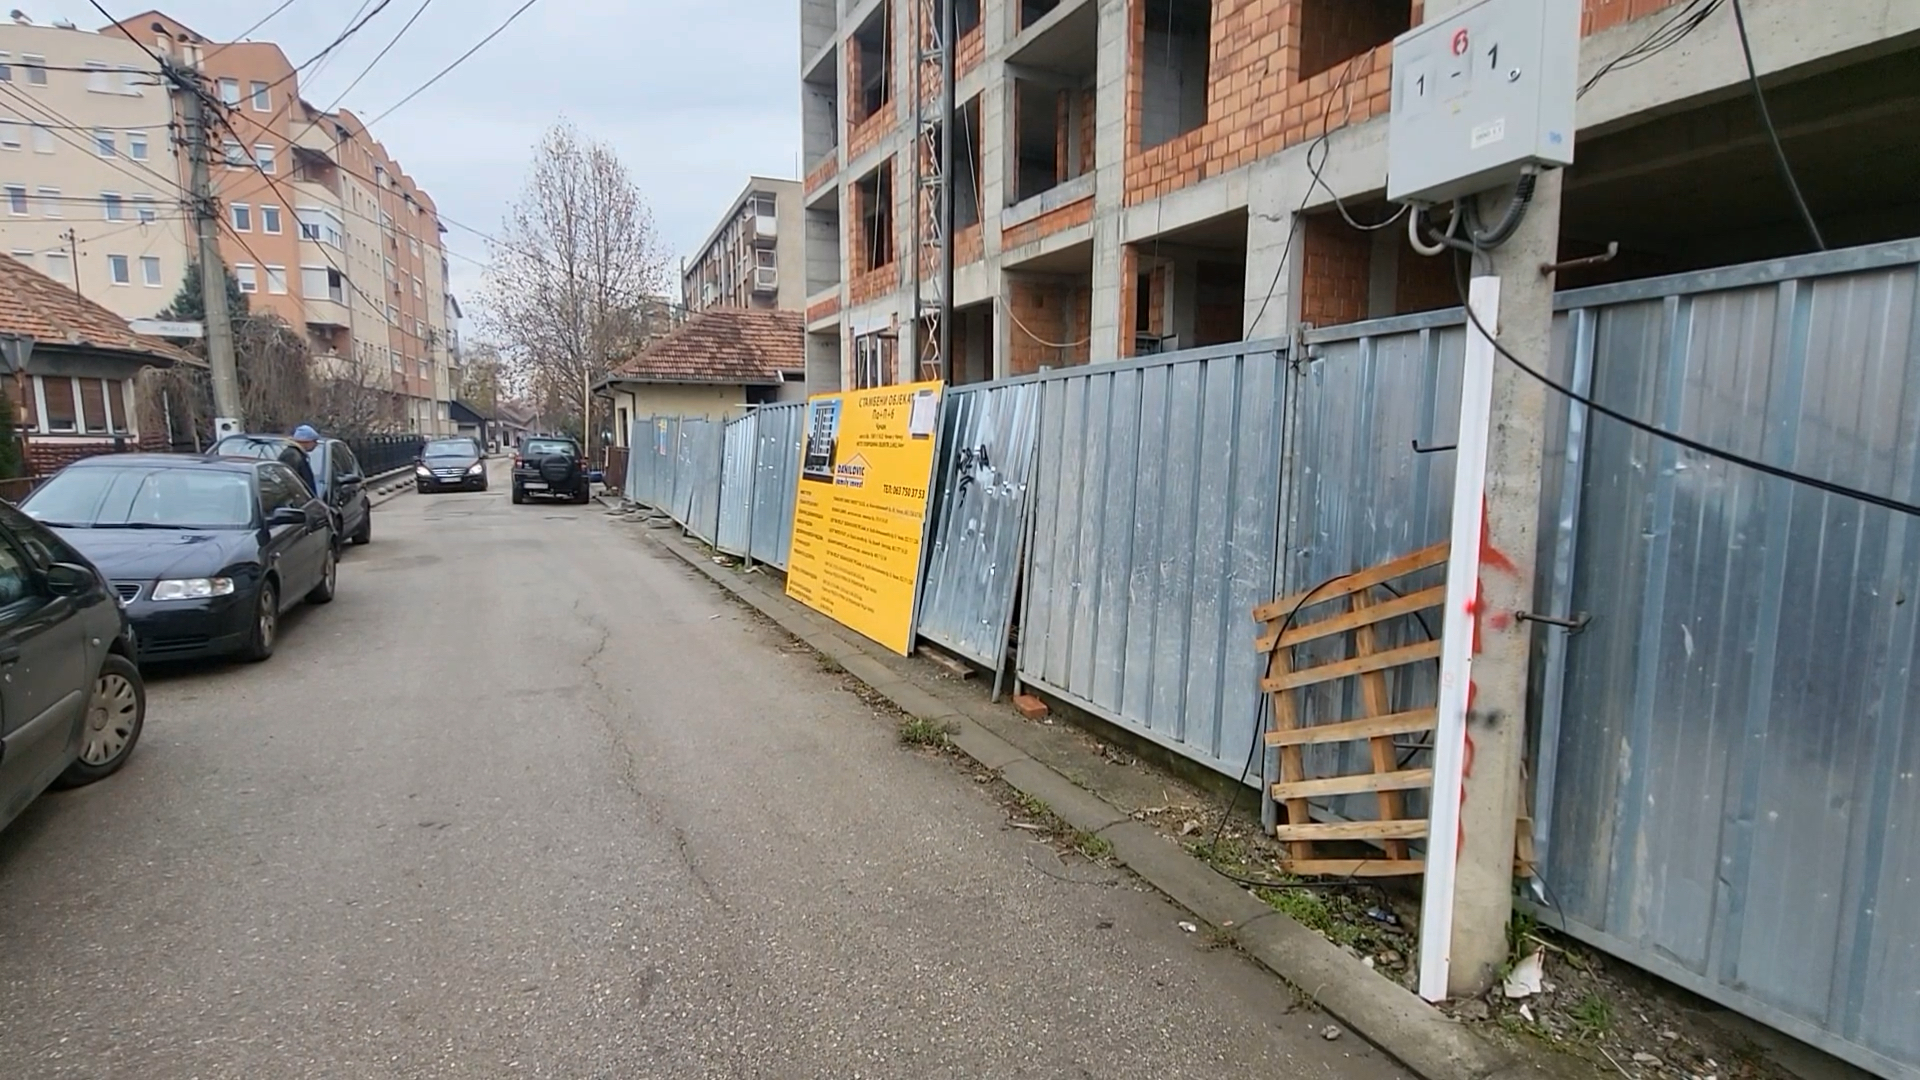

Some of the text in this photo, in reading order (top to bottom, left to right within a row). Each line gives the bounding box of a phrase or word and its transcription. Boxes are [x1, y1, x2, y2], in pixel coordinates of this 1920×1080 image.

[1452, 28, 1469, 57] 6
[1416, 74, 1425, 96] 1
[1487, 42, 1498, 70] 1
[858, 396, 888, 408] СТАМБЕНИ
[893, 485, 901, 495] 063
[901, 486, 911, 497] 750
[911, 488, 918, 498] 37
[918, 489, 925, 499] 53
